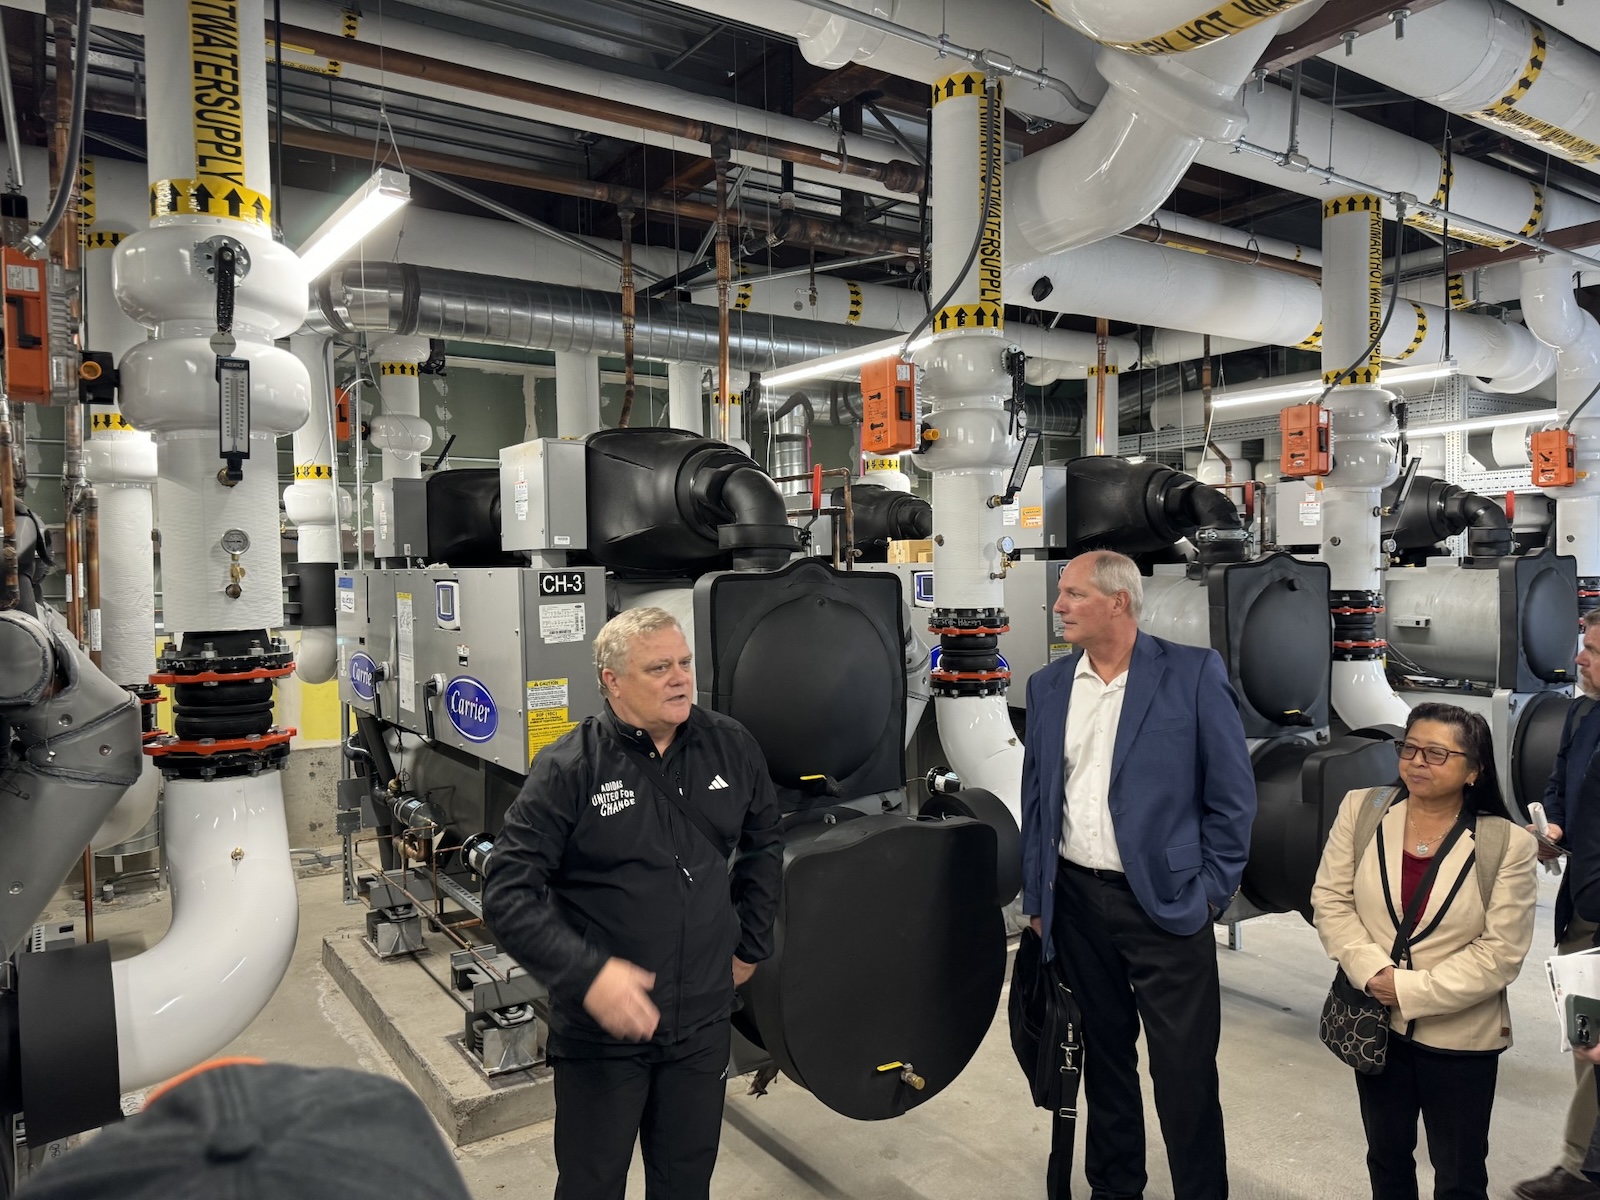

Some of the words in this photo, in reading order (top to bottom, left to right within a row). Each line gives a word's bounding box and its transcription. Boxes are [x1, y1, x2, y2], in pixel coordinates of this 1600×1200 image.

[1176, 10, 1243, 44] HOT
[542, 574, 583, 593] CH-3
[352, 661, 372, 687] Carrie
[450, 690, 490, 724] Carrier
[601, 780, 624, 793] ADIDAS
[591, 791, 619, 807] UNITED
[620, 789, 635, 798] FOR
[600, 798, 636, 817] CHANGE
